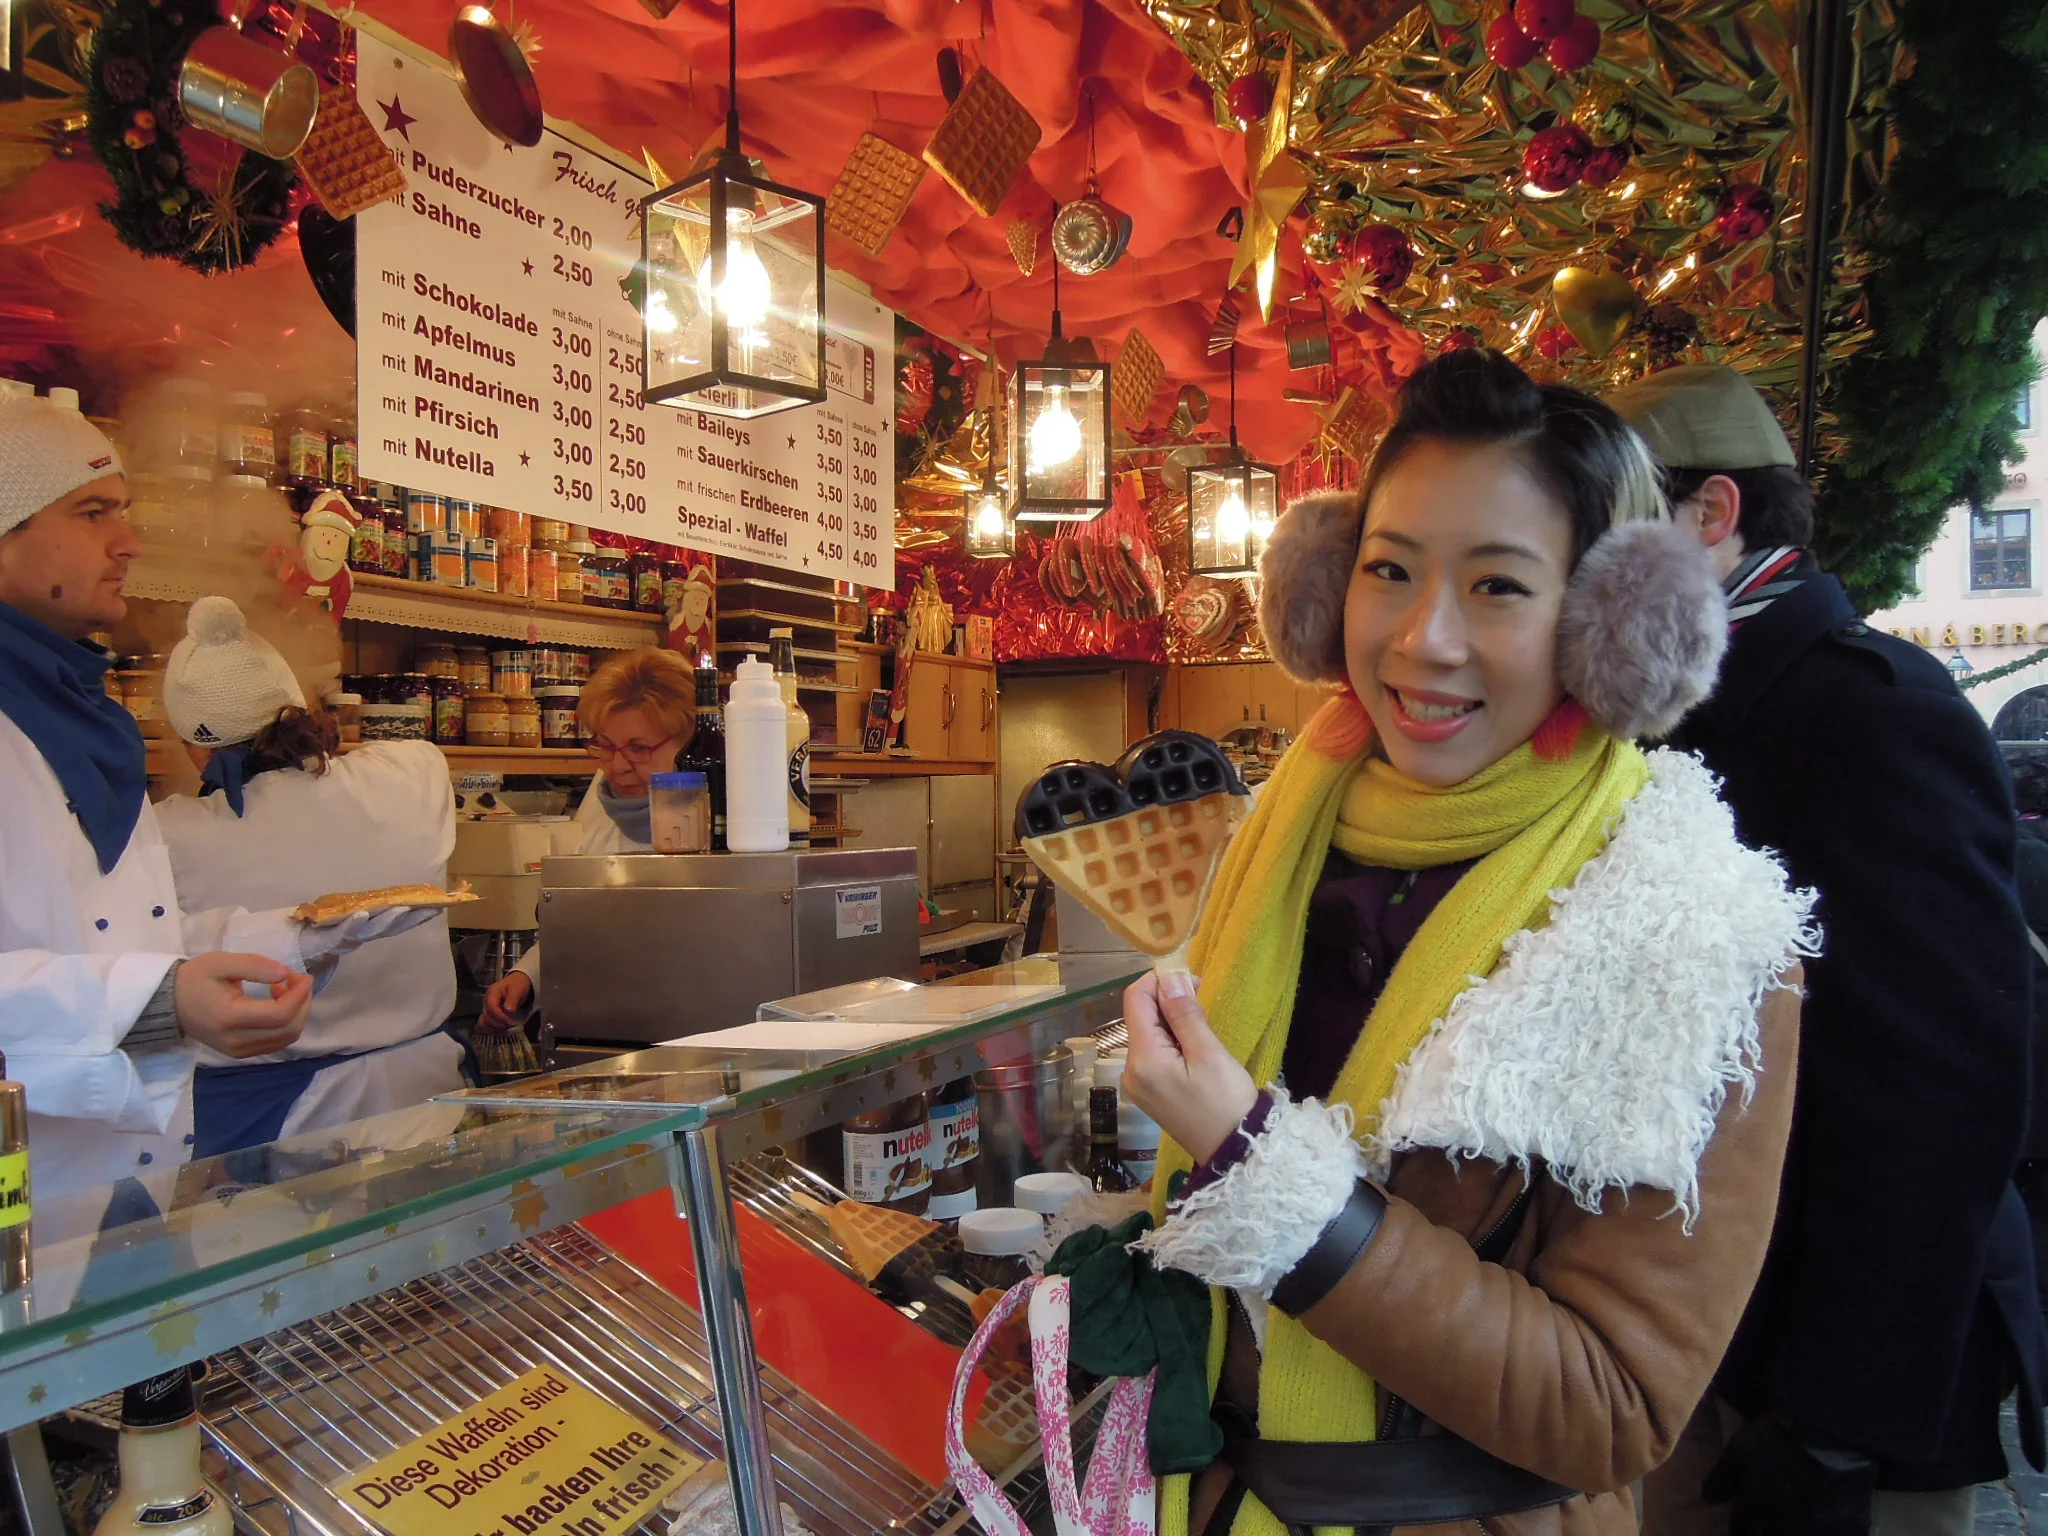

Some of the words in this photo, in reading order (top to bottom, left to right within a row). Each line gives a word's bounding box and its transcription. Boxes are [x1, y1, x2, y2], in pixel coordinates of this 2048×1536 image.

[387, 147, 405, 166] it
[412, 150, 545, 228] Puderzucker
[553, 217, 592, 251] 2,00
[552, 151, 618, 203] Frisch
[412, 192, 482, 239] Sahne
[553, 254, 592, 287] 2,50
[382, 268, 405, 289] mit
[413, 273, 538, 337] Schokolade
[552, 307, 566, 320] mit
[568, 311, 593, 330] Sahne
[382, 311, 406, 331] mit
[413, 315, 516, 367] Apfelmus
[552, 364, 592, 393] 3,00
[608, 383, 646, 411] 2,50
[552, 327, 592, 357] 3,00
[625, 332, 642, 348] Sahn
[865, 357, 873, 392] NEU
[382, 353, 406, 373] mit
[414, 355, 540, 413] Mandarinen
[553, 400, 592, 429] 3,00
[609, 418, 646, 445] 2,50
[382, 395, 407, 415] mit
[414, 396, 499, 440] Pfirsich
[553, 438, 592, 466] 3,00
[609, 454, 646, 480] 2,50
[677, 410, 693, 428] mit
[698, 414, 750, 445] Baileys
[817, 424, 843, 447] 3,50
[853, 437, 877, 459] 3,00
[383, 438, 407, 457] mit
[415, 437, 495, 477] Nutella
[553, 475, 593, 502] 3,50
[610, 489, 646, 515] 3,00
[677, 444, 693, 460] mit
[698, 445, 799, 490] Sauerkirschen
[817, 453, 843, 475] 3,50
[853, 465, 877, 485] 3,00
[677, 477, 693, 494] mit
[698, 482, 736, 504] frischen
[740, 489, 809, 523] Erdbeeren
[817, 482, 843, 504] 3,50
[853, 493, 877, 514] 3,00
[678, 505, 732, 535] Spezial
[744, 522, 788, 548] Waffel
[817, 511, 843, 532] 4,00
[853, 521, 877, 541] 3,50
[817, 540, 843, 561] 4,50
[853, 550, 877, 569] 4,00
[1942, 624, 1961, 647] &
[868, 730, 881, 750] 62
[352, 1457, 440, 1510] Diese
[427, 1406, 525, 1462] Waffeln
[519, 1373, 569, 1411] sind
[424, 1421, 559, 1510] Dekoration
[501, 1466, 606, 1536] backen
[590, 1429, 652, 1480] Ihre
[592, 1462, 675, 1522] frisch
[659, 1447, 688, 1466] !
